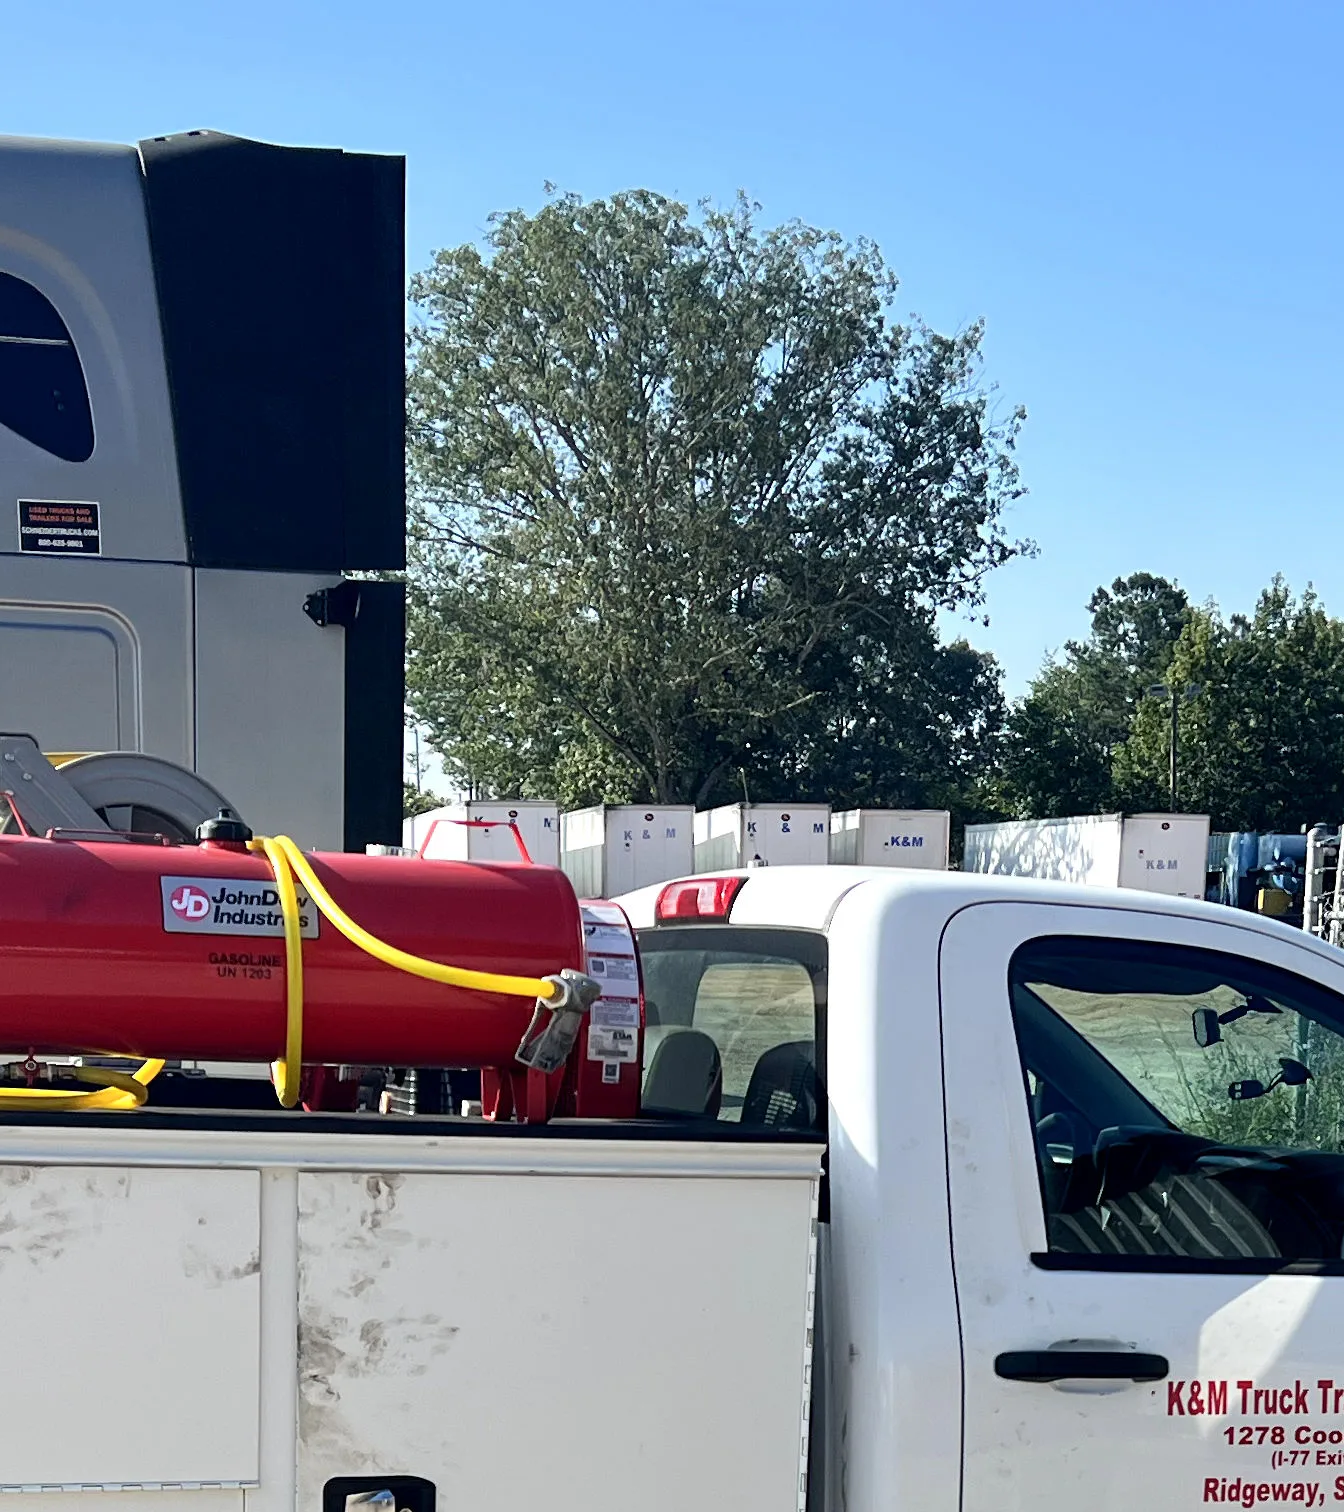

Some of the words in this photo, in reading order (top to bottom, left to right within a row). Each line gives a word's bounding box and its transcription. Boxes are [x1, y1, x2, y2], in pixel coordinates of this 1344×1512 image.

[890, 835, 923, 847] K&M
[209, 952, 282, 967] GASOLINE
[217, 966, 237, 978] UN
[243, 967, 272, 980] 1203
[1167, 1379, 1228, 1416] K&M
[1236, 1379, 1310, 1415] Truck
[1223, 1425, 1285, 1445] 1278
[1270, 1450, 1311, 1470] (I-77
[1203, 1477, 1325, 1508] Ridgeway,
